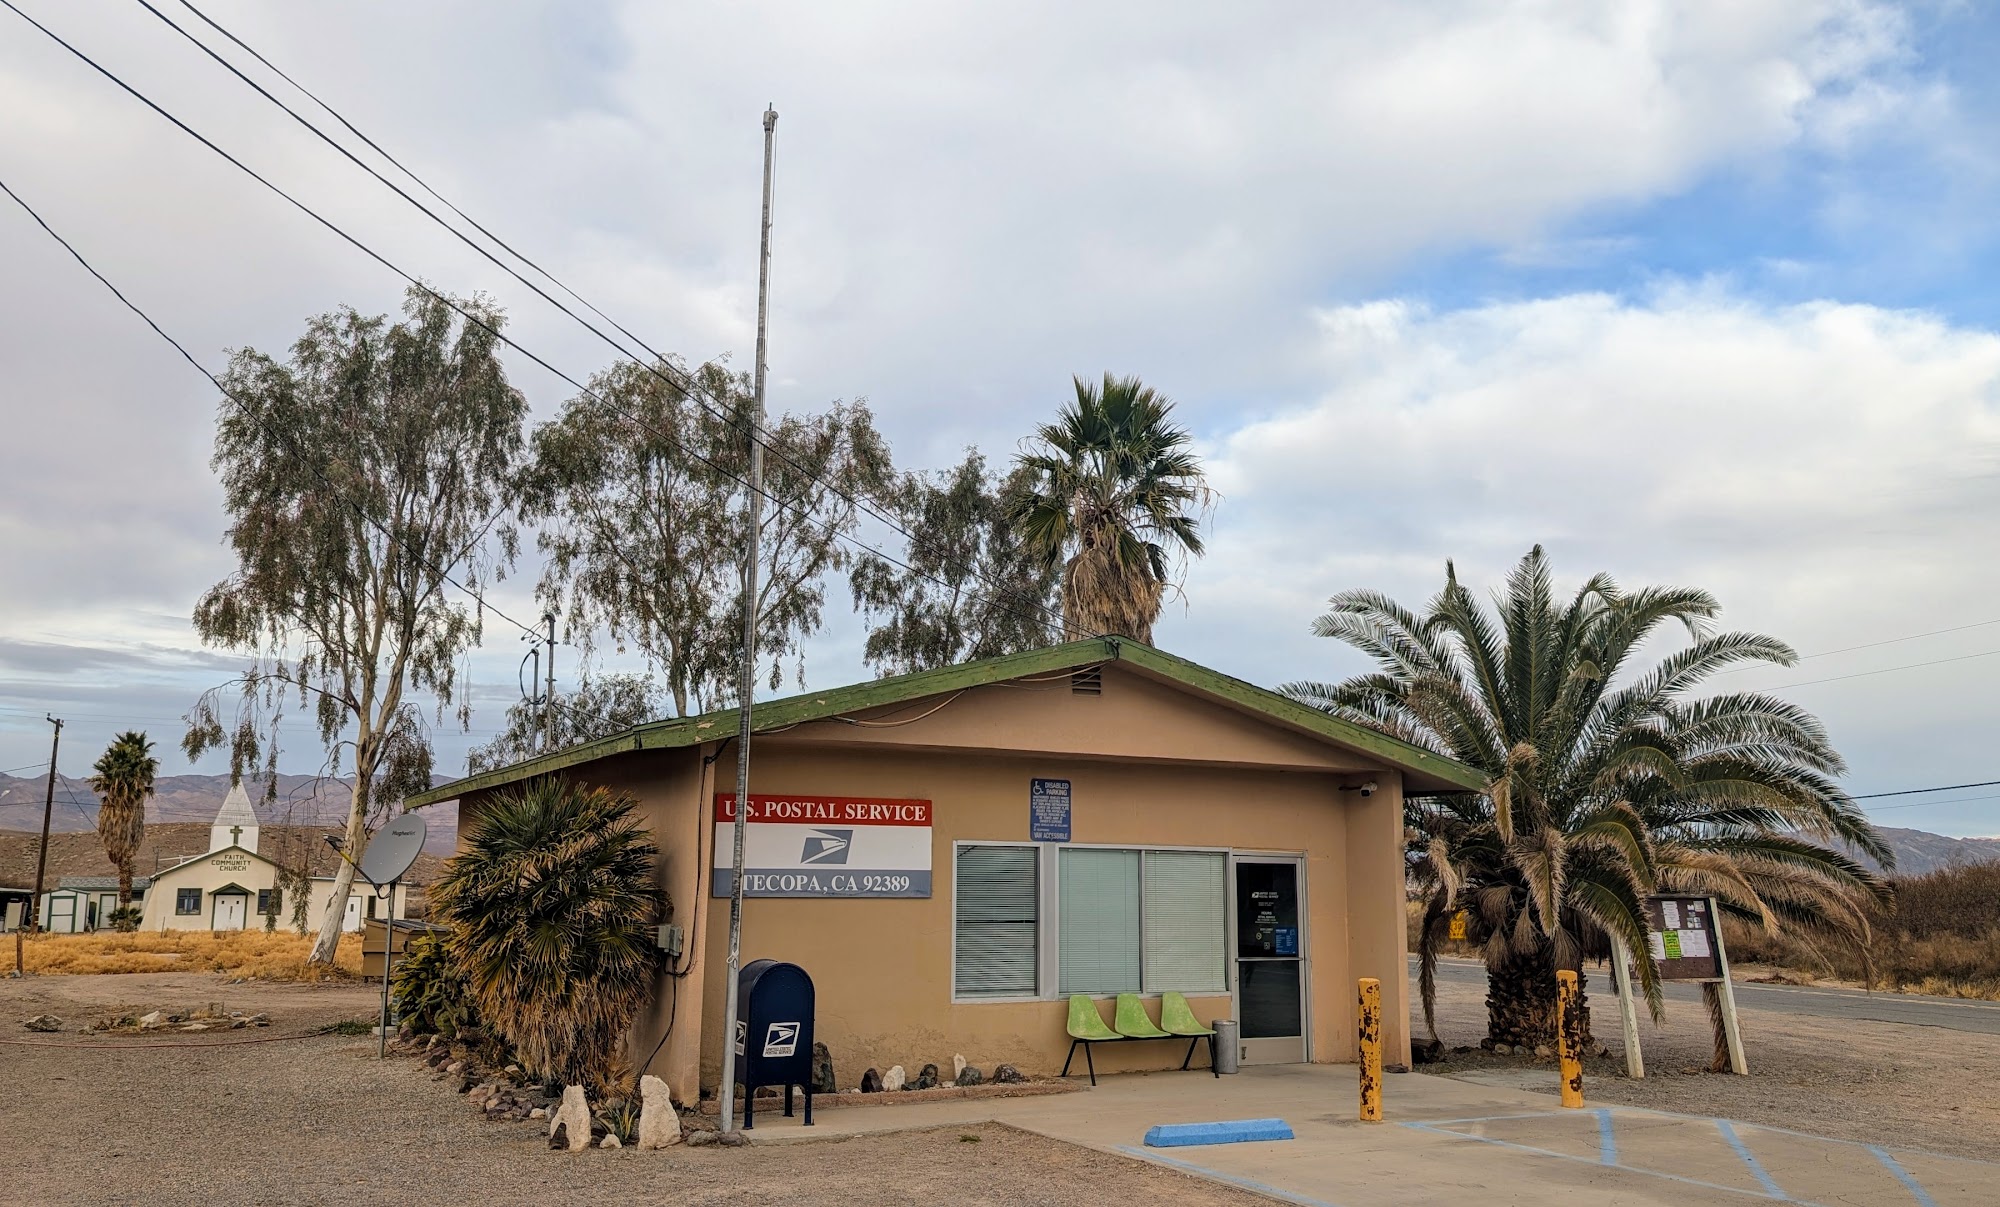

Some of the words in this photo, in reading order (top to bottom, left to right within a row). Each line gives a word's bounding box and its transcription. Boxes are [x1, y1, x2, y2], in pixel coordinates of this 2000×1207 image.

[1044, 782, 1069, 790] DISABLED
[764, 801, 841, 819] POSTAL
[845, 803, 926, 821] SERVICE
[742, 874, 827, 895] TECOPA,
[831, 875, 857, 891] CA
[863, 875, 910, 891] 92389
